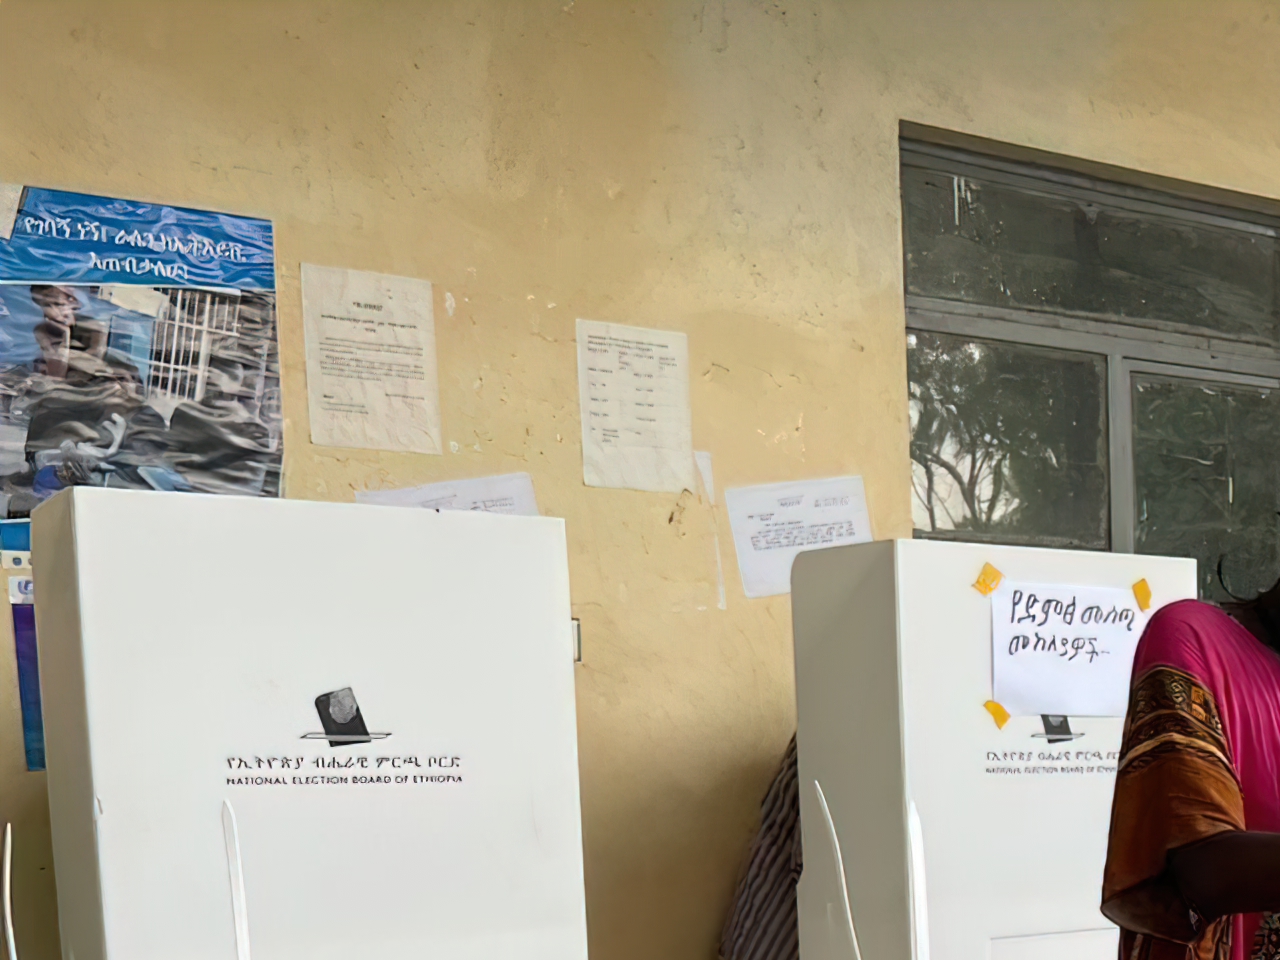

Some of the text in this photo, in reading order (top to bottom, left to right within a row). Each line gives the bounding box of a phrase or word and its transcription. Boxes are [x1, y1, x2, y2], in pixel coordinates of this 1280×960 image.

[226, 774, 463, 786] NATIONAL ELECTION BOARD OF ETHIOPIA
